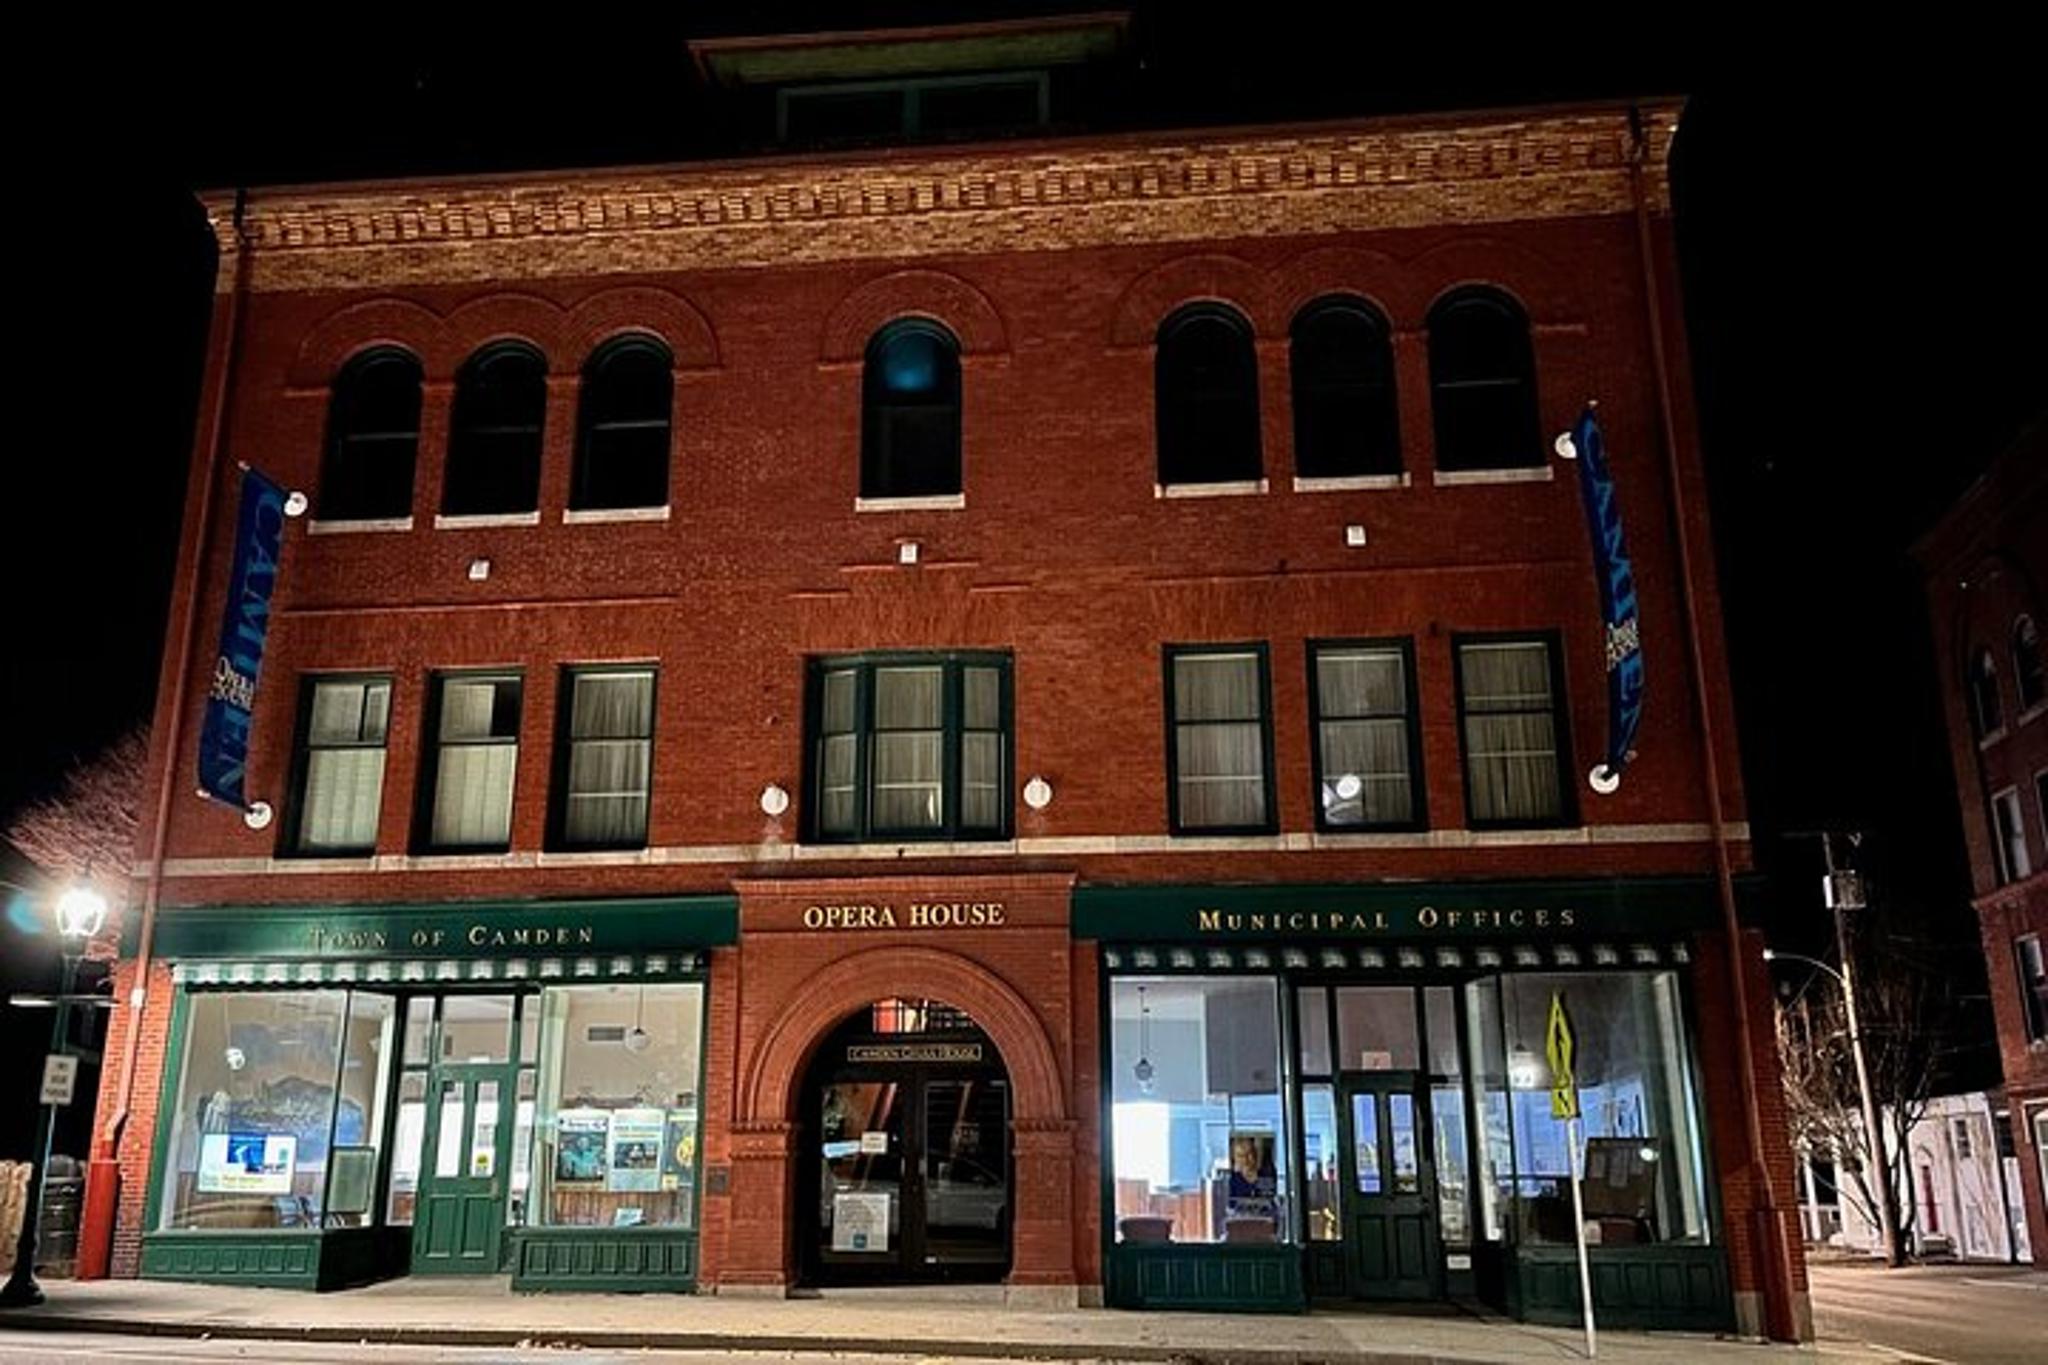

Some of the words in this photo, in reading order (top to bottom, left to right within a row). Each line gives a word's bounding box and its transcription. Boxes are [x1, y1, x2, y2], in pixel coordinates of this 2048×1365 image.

[803, 906, 897, 928] OPERA
[909, 904, 1005, 926] HOUSE
[1199, 910, 1389, 931] MUNICIPAL
[1417, 907, 1575, 928] OFFICES
[309, 928, 387, 949] TOWN
[412, 929, 445, 945] OF
[469, 926, 593, 945] CAMDEN
